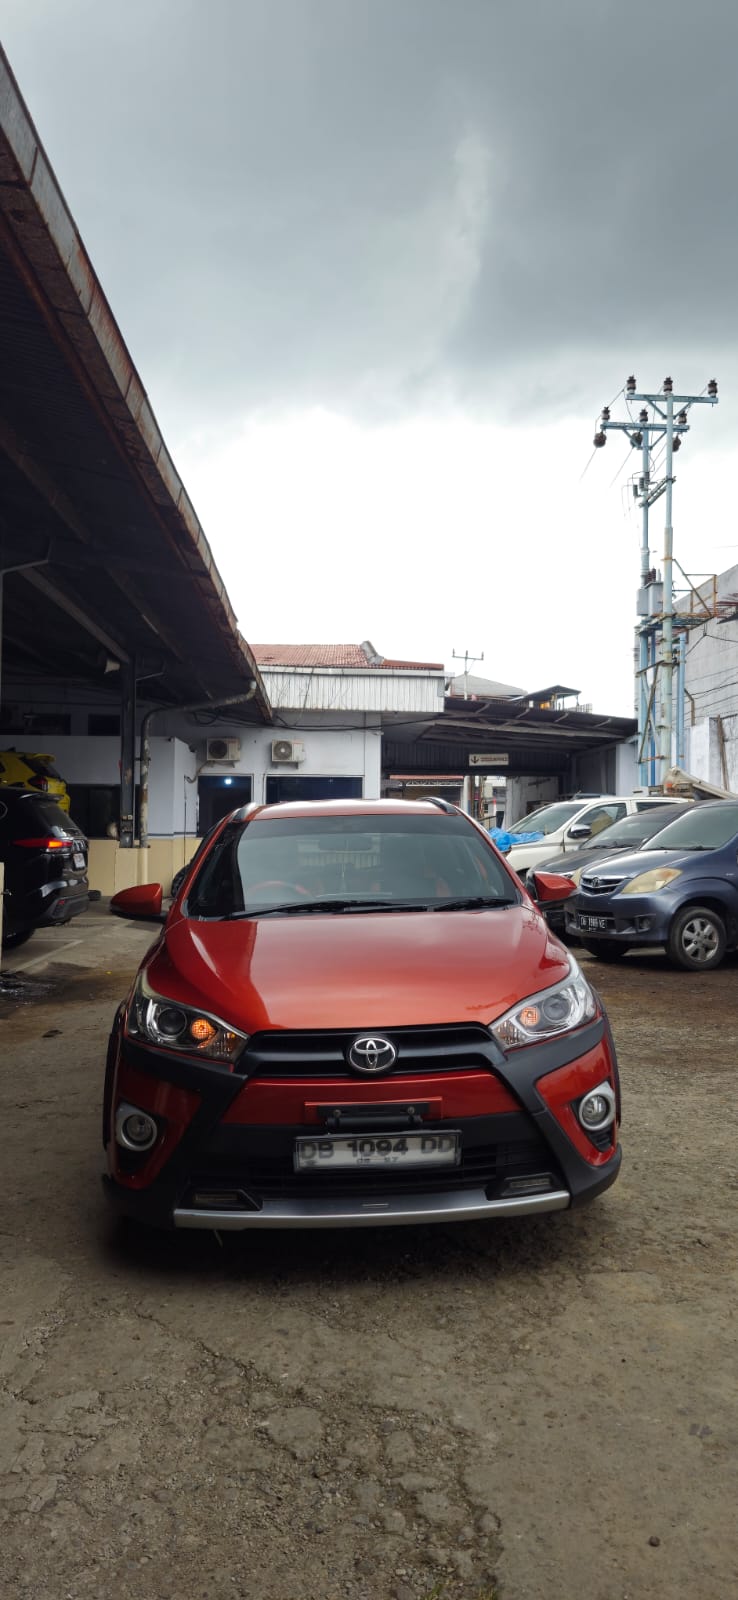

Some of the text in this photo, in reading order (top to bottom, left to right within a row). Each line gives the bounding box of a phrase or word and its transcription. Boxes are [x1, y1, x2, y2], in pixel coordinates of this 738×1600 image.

[299, 1136, 456, 1159] DB 1094 DD
